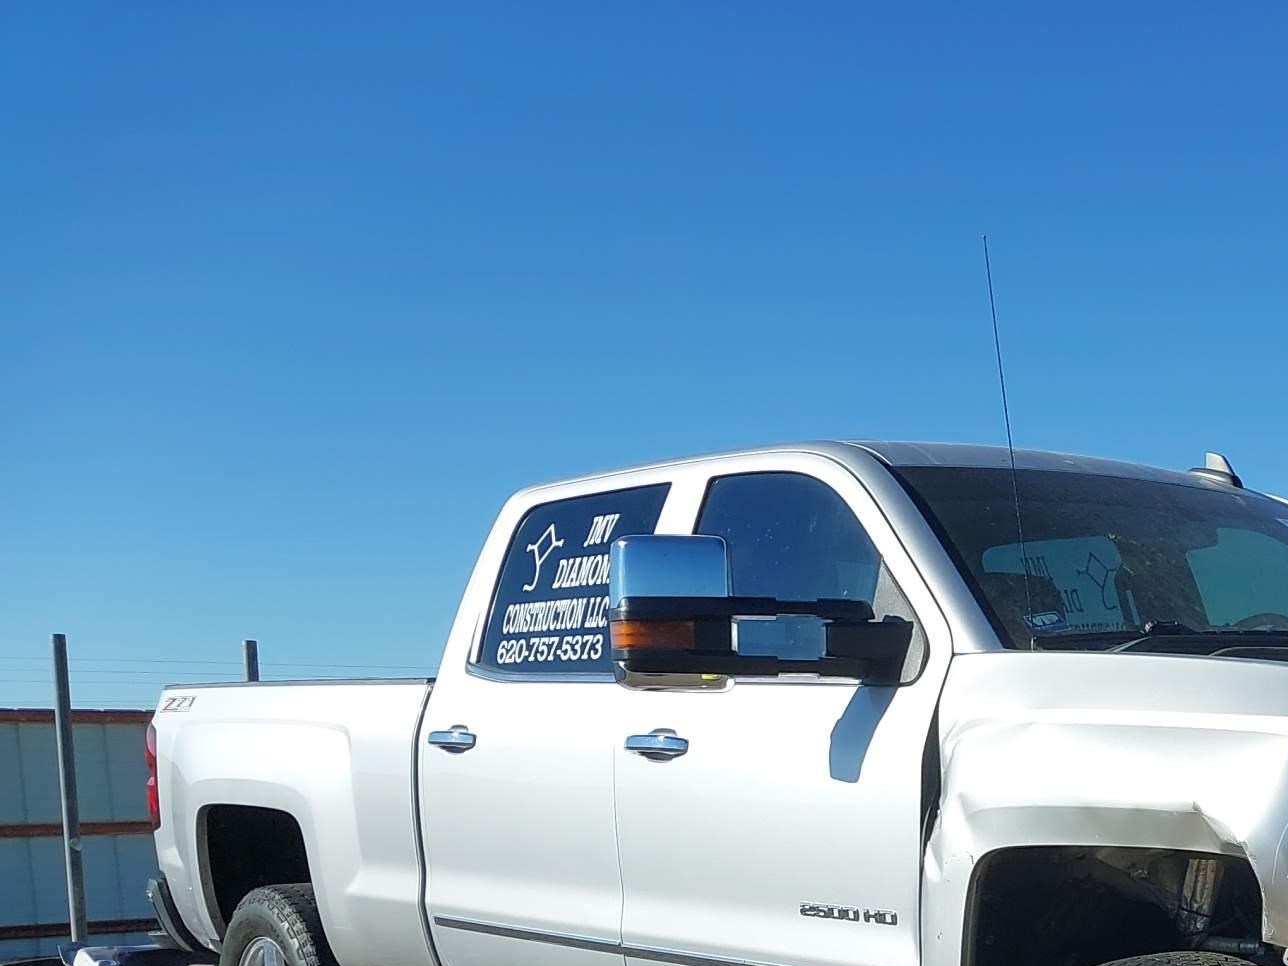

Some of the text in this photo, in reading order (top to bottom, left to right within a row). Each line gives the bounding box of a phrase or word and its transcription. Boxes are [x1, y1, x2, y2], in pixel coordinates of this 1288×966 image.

[583, 513, 621, 548] JMV
[551, 554, 610, 589] DIAMON
[502, 598, 588, 634] CONSTRUCTION
[496, 634, 604, 664] 620-757-5373
[160, 696, 197, 711] Z71
